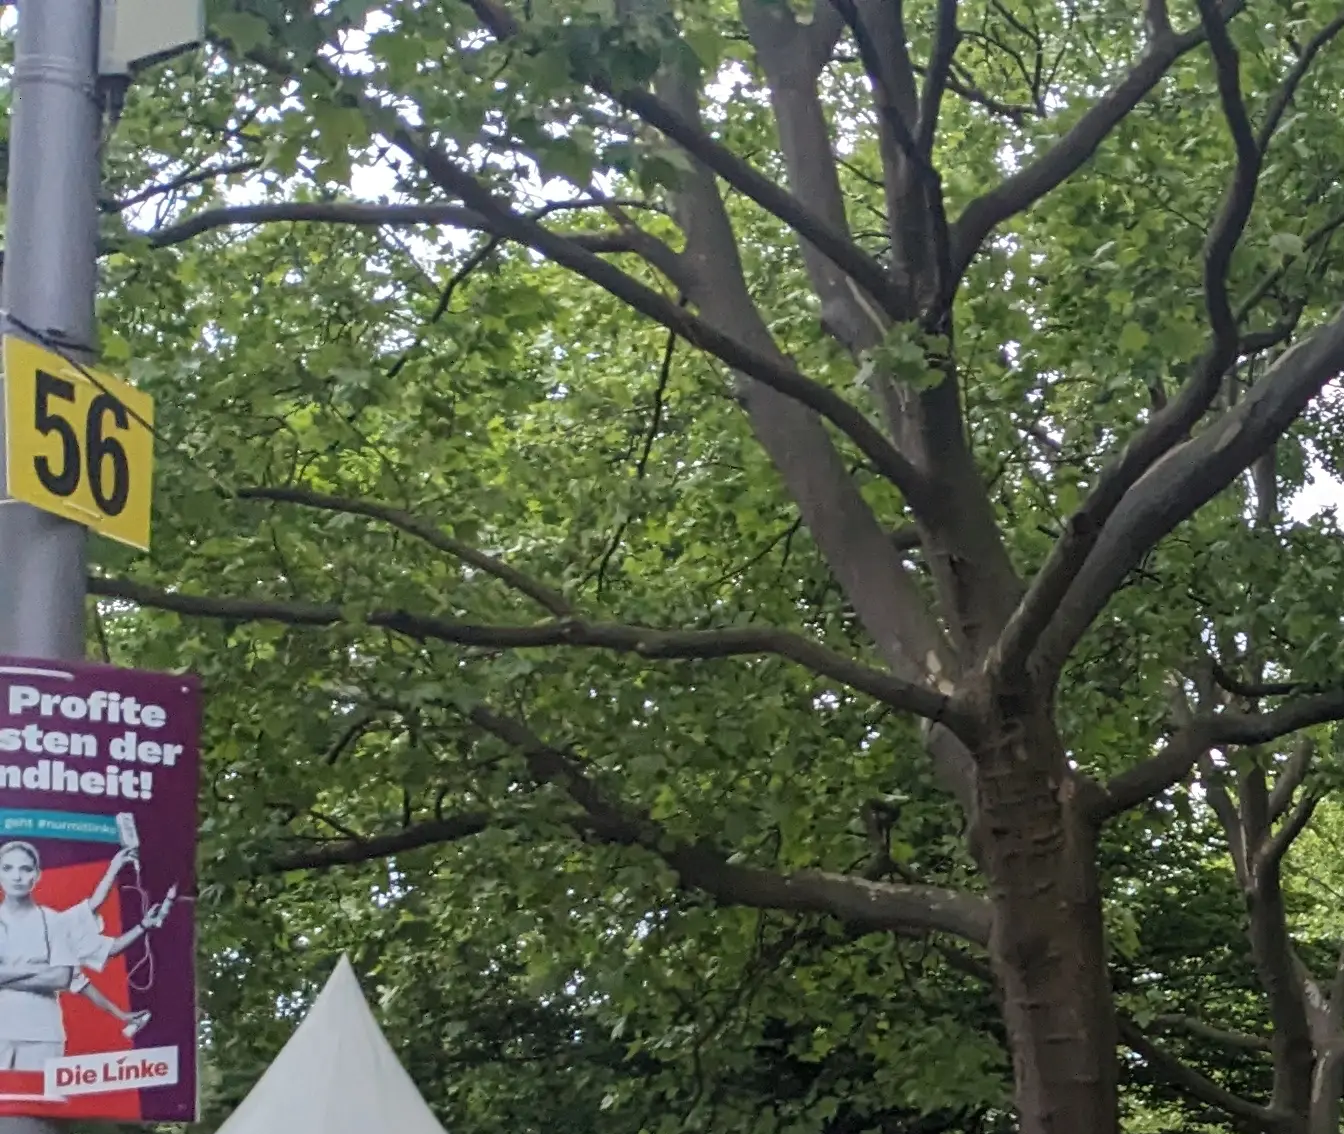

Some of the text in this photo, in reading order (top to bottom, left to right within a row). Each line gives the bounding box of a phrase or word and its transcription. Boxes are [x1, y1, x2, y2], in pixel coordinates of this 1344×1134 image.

[34, 369, 130, 516] 56
[9, 685, 167, 728] Profite
[0, 724, 184, 766] sten der
[0, 759, 153, 800] ndheit!
[56, 1056, 169, 1087] Die Linke
